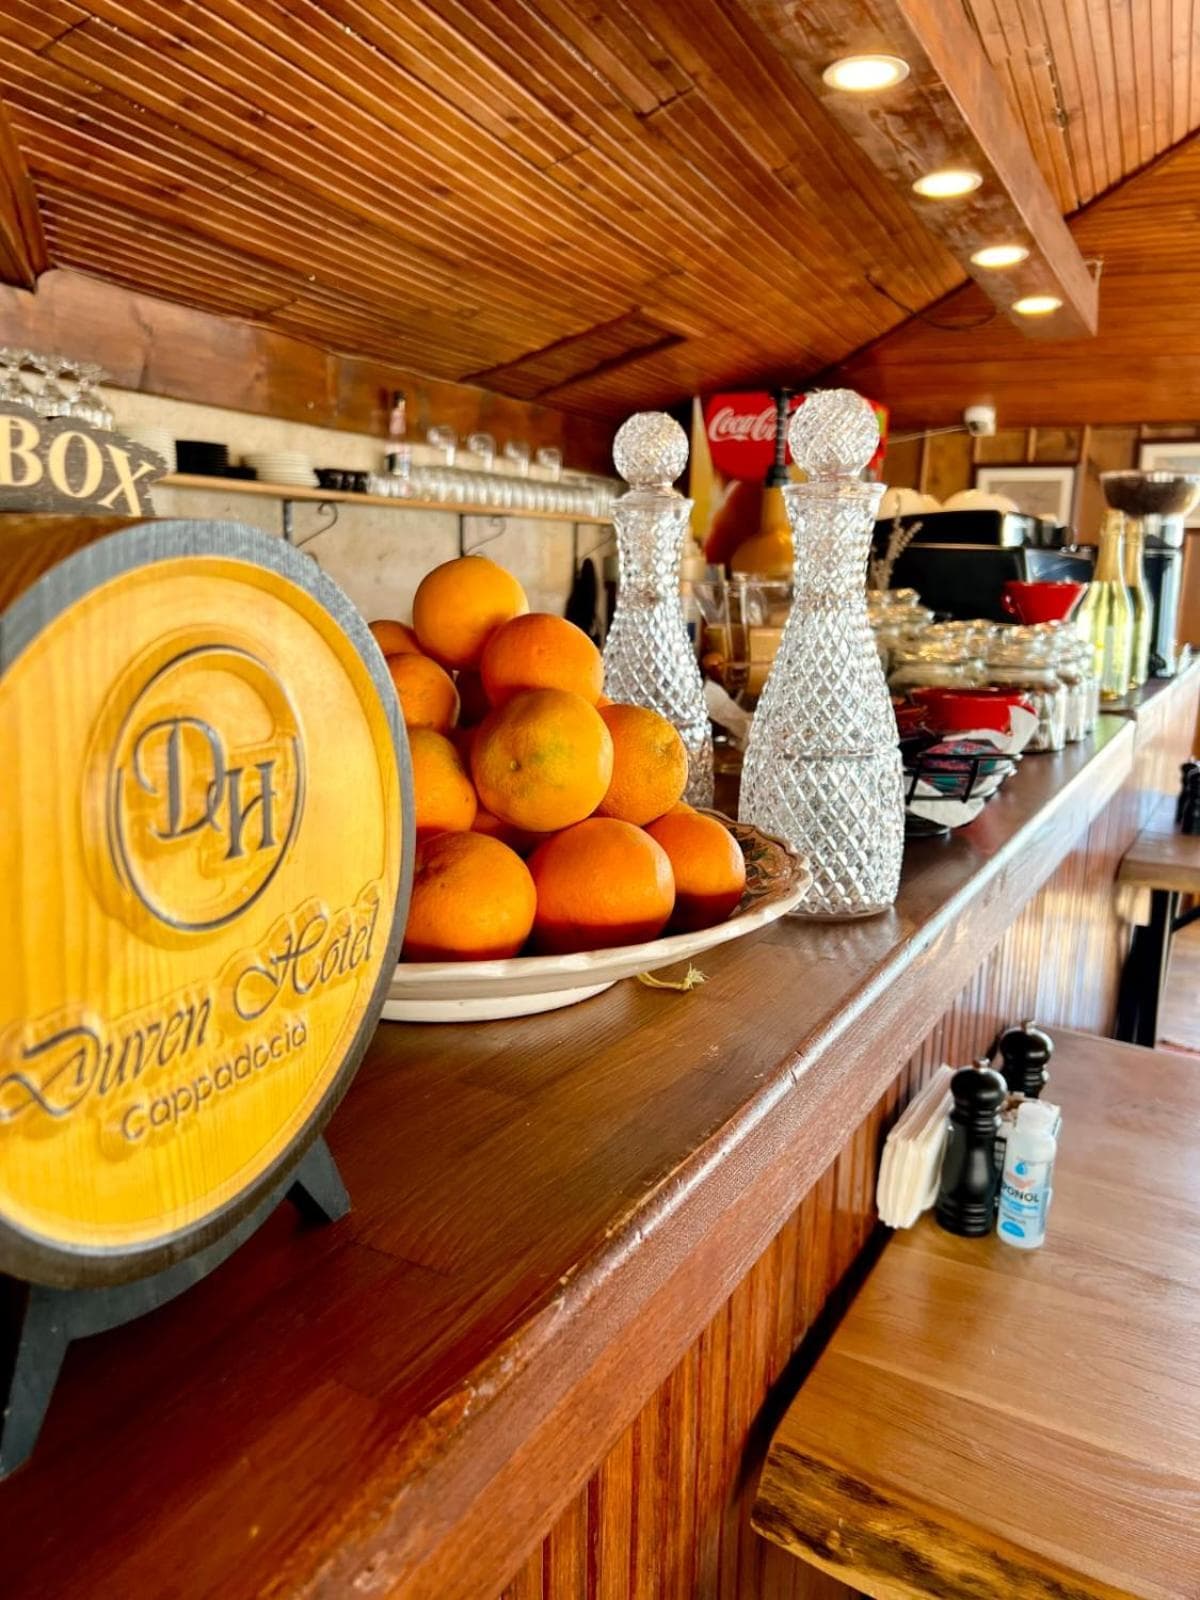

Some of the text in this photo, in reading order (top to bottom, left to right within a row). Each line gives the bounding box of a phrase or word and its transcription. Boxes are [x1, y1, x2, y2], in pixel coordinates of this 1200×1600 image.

[0, 414, 156, 517] BOX
[134, 716, 277, 859] DH
[233, 897, 380, 1021] Hotel
